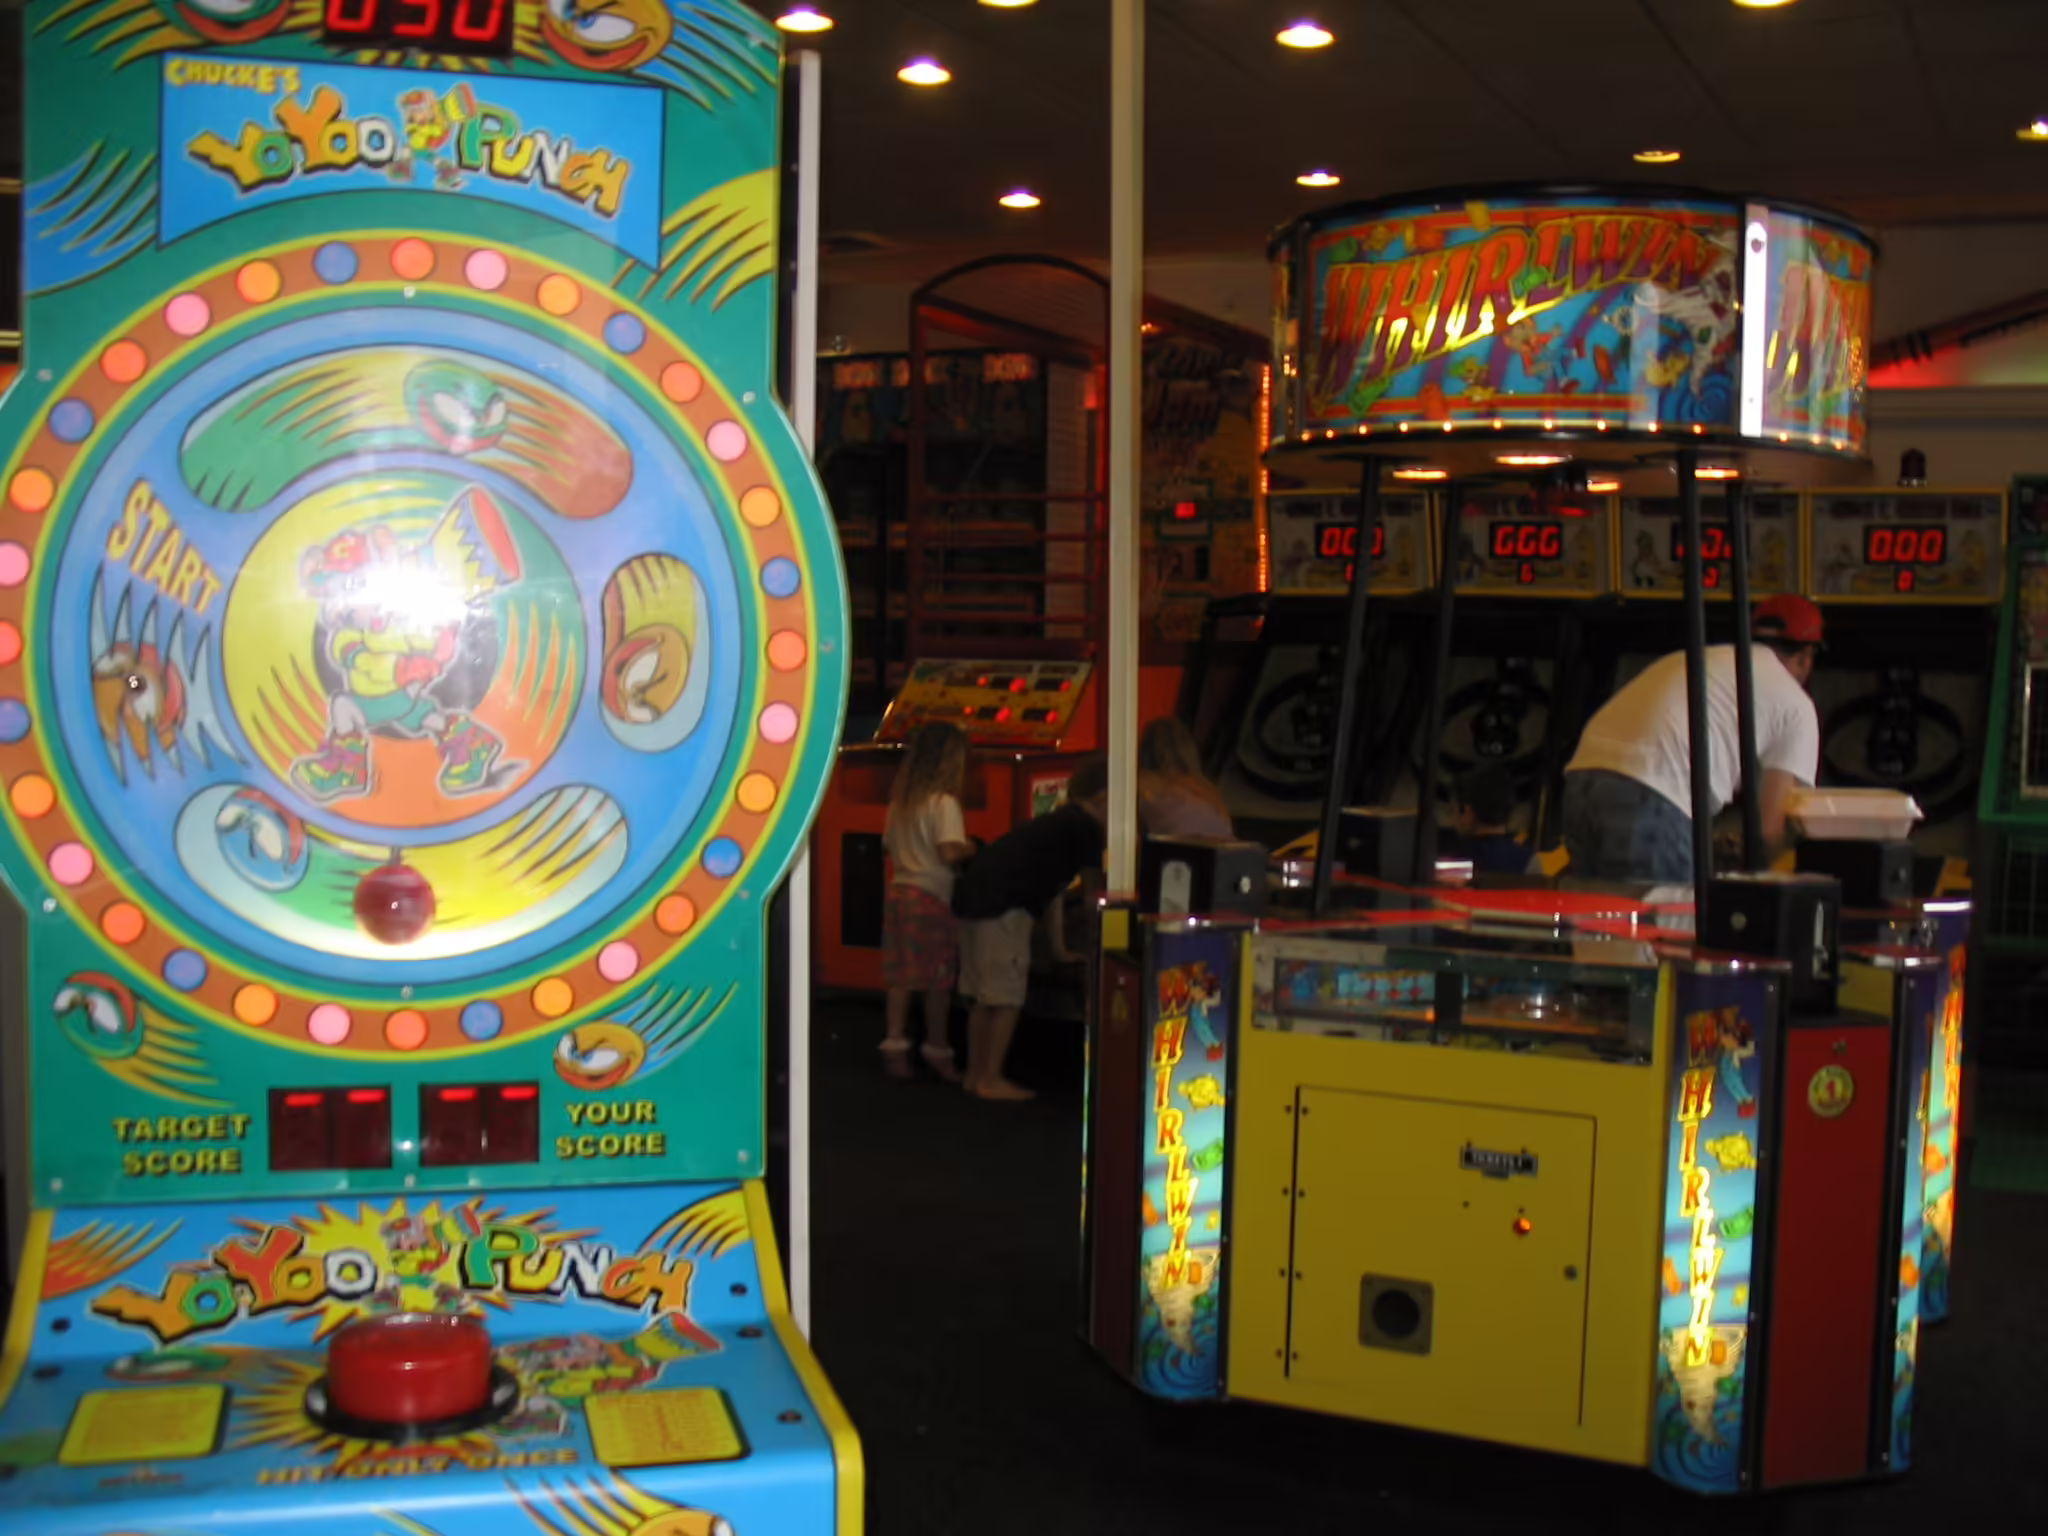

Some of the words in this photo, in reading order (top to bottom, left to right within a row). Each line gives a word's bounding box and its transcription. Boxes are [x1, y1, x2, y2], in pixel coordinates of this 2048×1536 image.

[106, 478, 225, 615] START
[1870, 529, 1944, 563] 000
[112, 1114, 251, 1141] TARGET
[566, 1100, 657, 1127] YOUR
[555, 1132, 665, 1160] SCORE
[123, 1149, 243, 1176] SCORE
[349, 1455, 450, 1478] ONLY
[468, 1448, 578, 1470] ONCE
